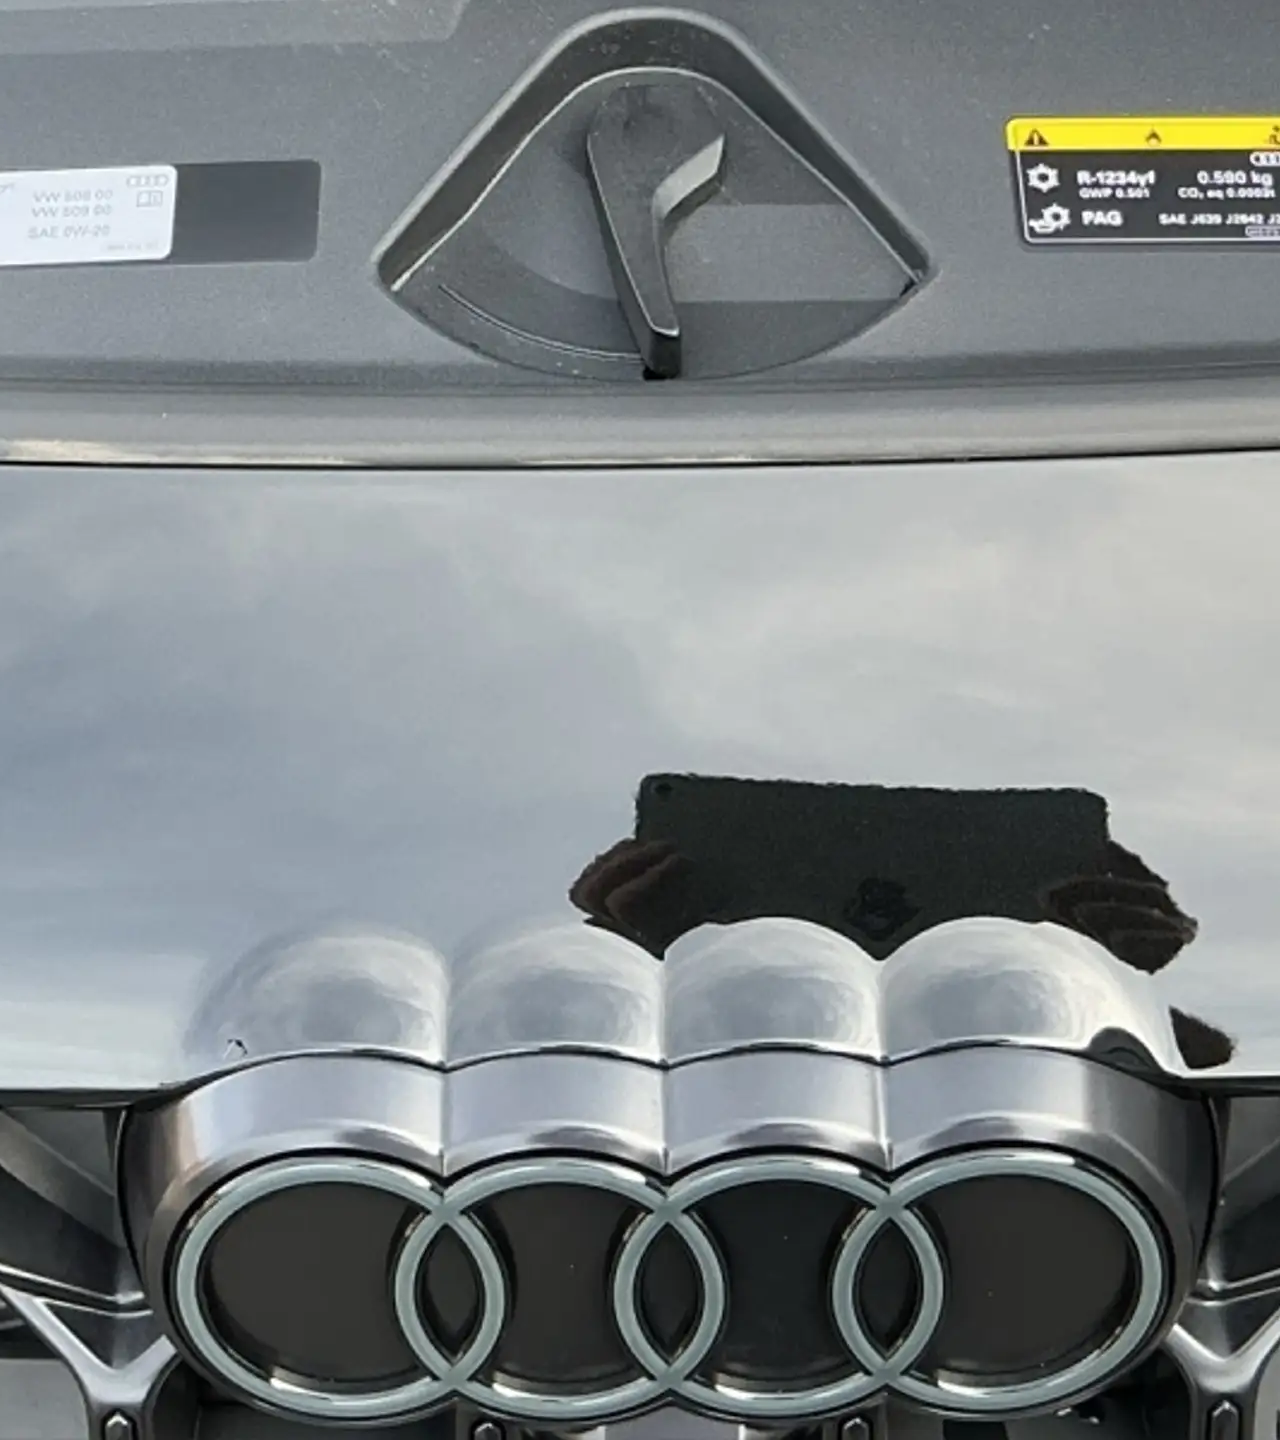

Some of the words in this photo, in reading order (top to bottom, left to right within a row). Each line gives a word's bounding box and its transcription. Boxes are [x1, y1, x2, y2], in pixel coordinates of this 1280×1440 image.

[1077, 170, 1155, 187] R-1234yf
[1250, 171, 1273, 188] kg
[33, 191, 60, 203] VW
[95, 189, 113, 201] 00
[1079, 187, 1113, 198] GWP
[32, 206, 60, 218] VW
[94, 205, 112, 216] 00
[1082, 210, 1123, 226] PAG
[1158, 213, 1188, 225] SAE
[1190, 213, 1223, 225] J639
[28, 227, 58, 239] SAE
[64, 225, 111, 238] 0W-20
